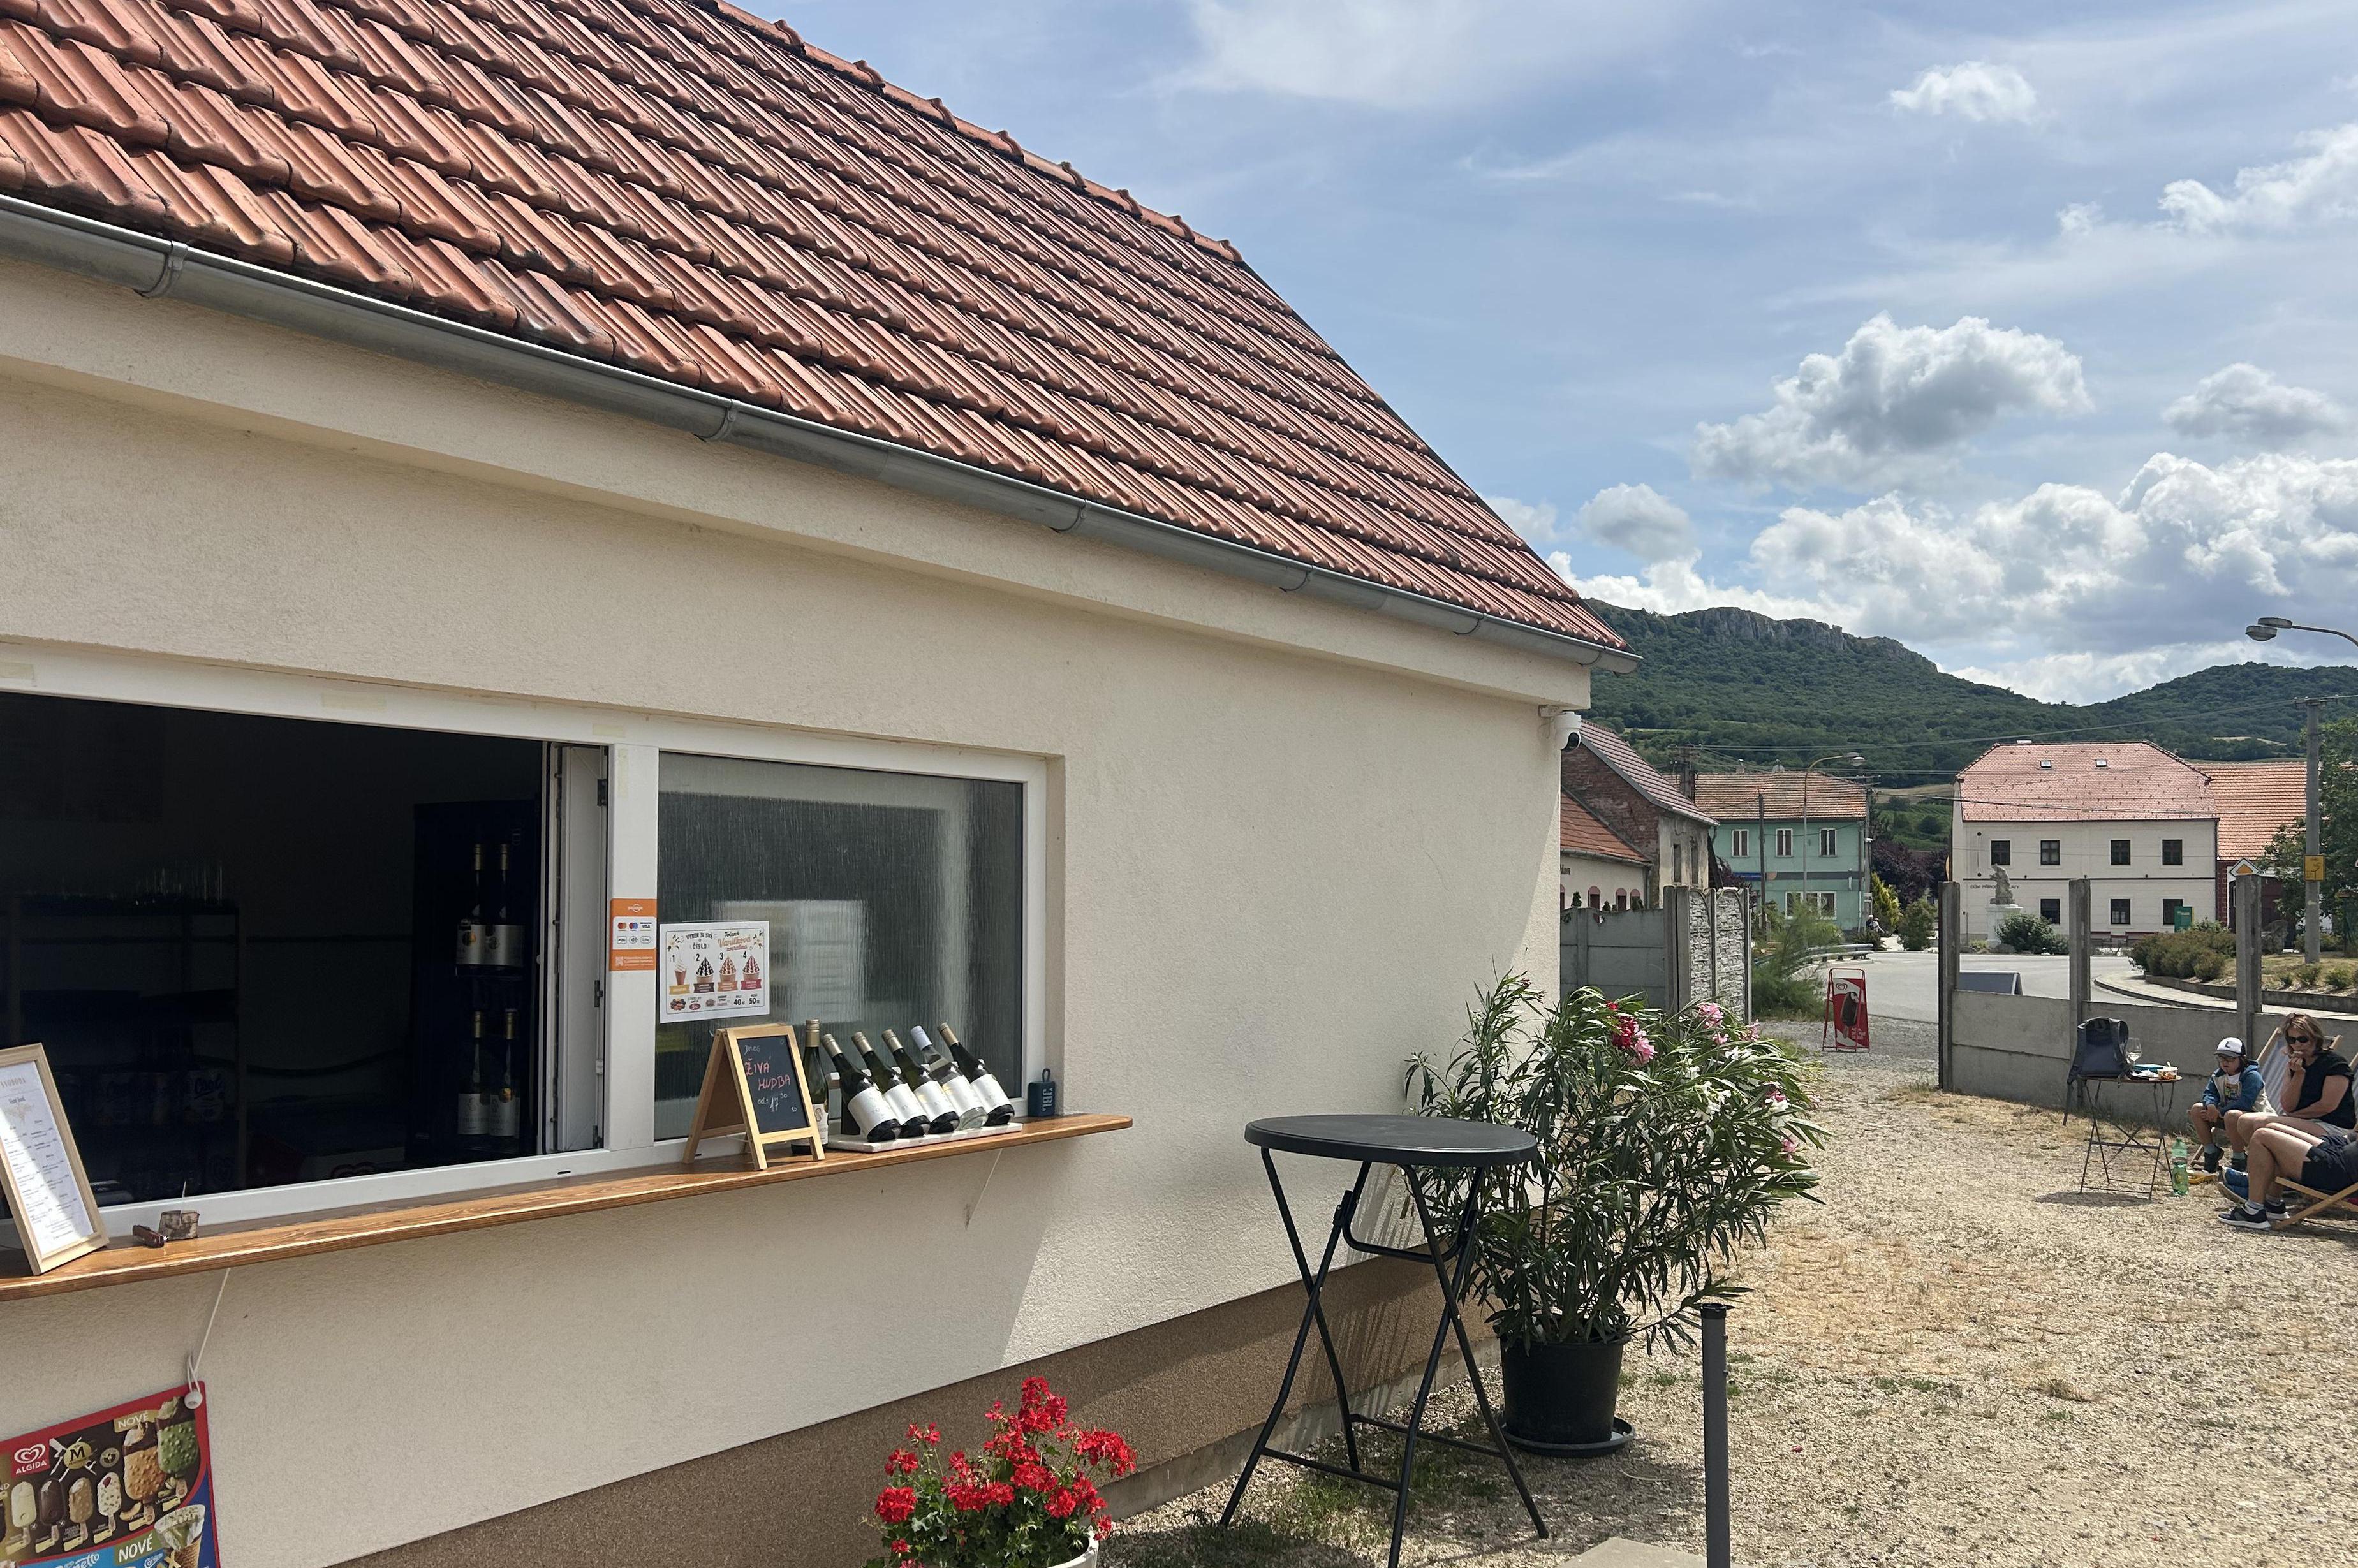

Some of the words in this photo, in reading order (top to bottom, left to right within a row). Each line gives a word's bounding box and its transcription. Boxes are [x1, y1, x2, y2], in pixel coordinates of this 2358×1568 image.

[672, 955, 675, 963] 1
[696, 953, 700, 962] 2
[719, 952, 724, 960] 3
[742, 951, 747, 959] 4
[744, 1056, 771, 1076] ŽIVÁ
[758, 1074, 791, 1091] HUDBA
[1042, 1088, 1053, 1111] JBL
[117, 1411, 149, 1430] NOVÉ
[70, 1446, 85, 1462] M
[15, 1460, 47, 1475] ALGIDA
[118, 1534, 153, 1562] NOVÉ
